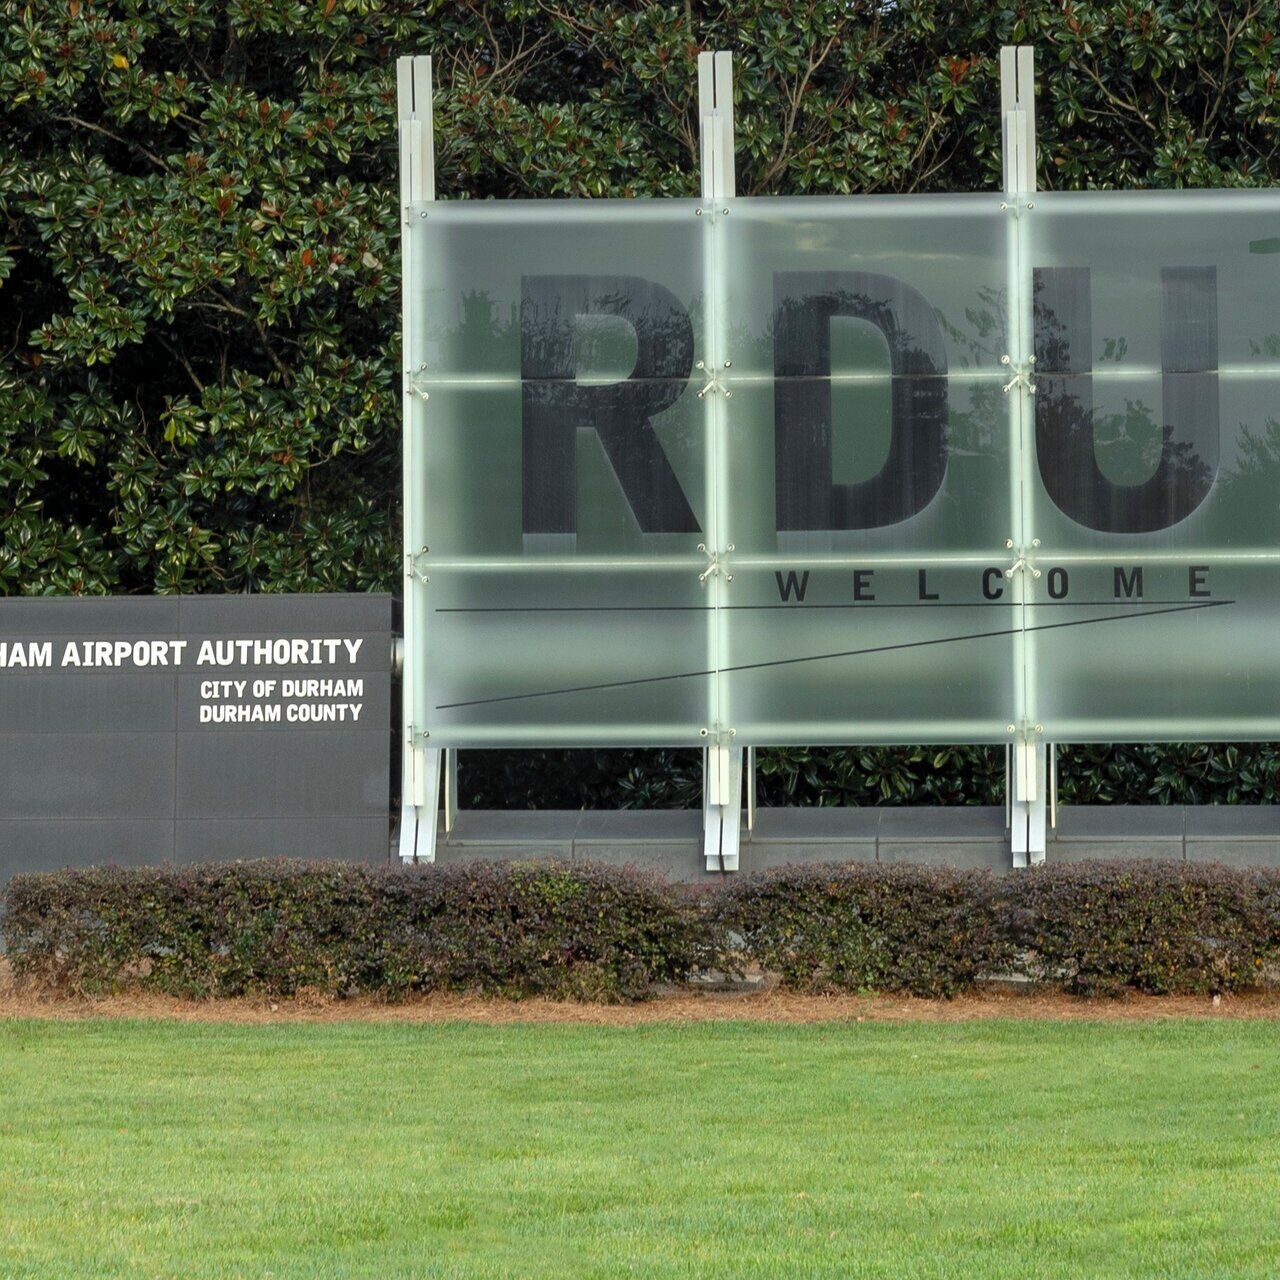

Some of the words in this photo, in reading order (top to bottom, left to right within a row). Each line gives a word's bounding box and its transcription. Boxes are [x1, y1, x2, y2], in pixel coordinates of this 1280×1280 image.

[521, 265, 1221, 535] RDU
[774, 566, 1212, 602] WELCOME
[60, 640, 188, 667] AIRPORT
[196, 638, 364, 666] AUTHORITY
[200, 680, 247, 699] CITY
[252, 679, 277, 698] OF
[281, 678, 364, 698] DURHAM
[199, 704, 282, 723] DURHAM
[286, 703, 363, 722] COUNTY
